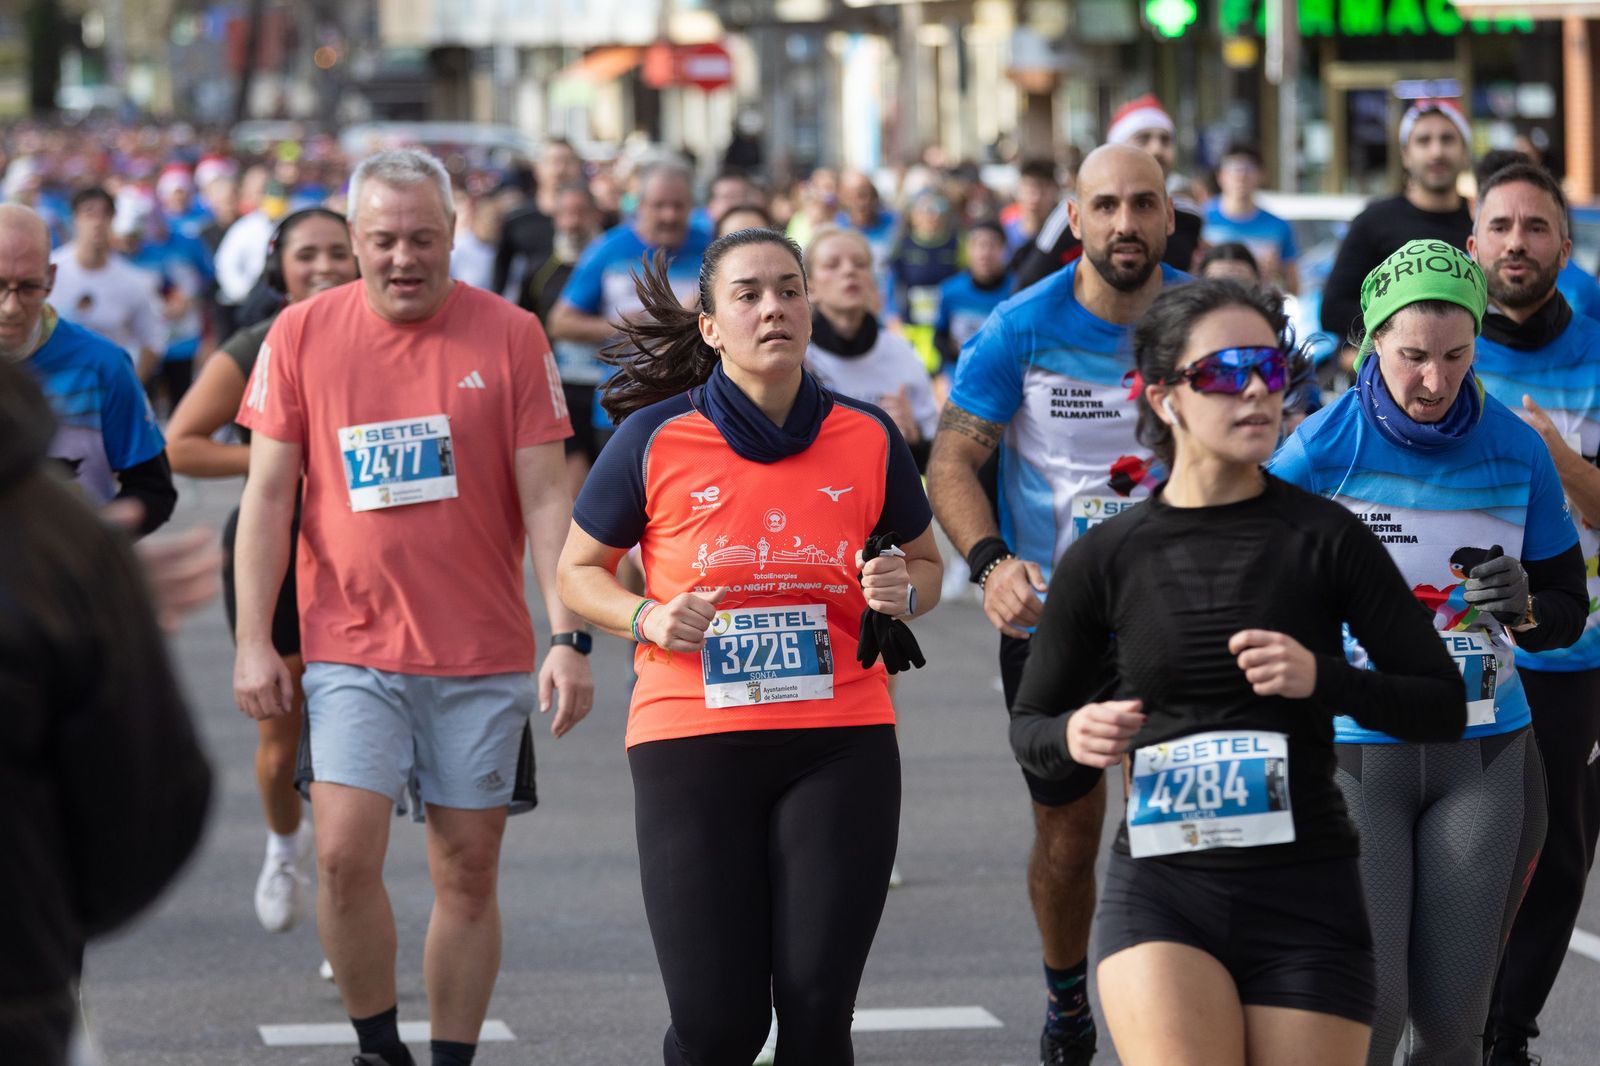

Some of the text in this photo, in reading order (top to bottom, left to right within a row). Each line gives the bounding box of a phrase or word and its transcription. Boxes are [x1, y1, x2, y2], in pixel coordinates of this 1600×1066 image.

[1394, 256, 1477, 290] RIOJA
[1051, 388, 1091, 397] XLI SAN
[1051, 400, 1103, 408] SILVESTRE
[1051, 410, 1120, 418] SALMANTINA
[365, 422, 438, 442] SETEL
[355, 441, 422, 483] 2477
[1370, 513, 1391, 521] SAN
[743, 583, 776, 591] NIGHT
[778, 582, 822, 590] RUNNING
[823, 584, 848, 593] FEST
[734, 611, 816, 631] SETEL
[719, 632, 802, 675] 3226
[763, 685, 798, 694] Ayuntamiento
[1172, 738, 1269, 763] SETEL
[1147, 760, 1250, 814] 4284
